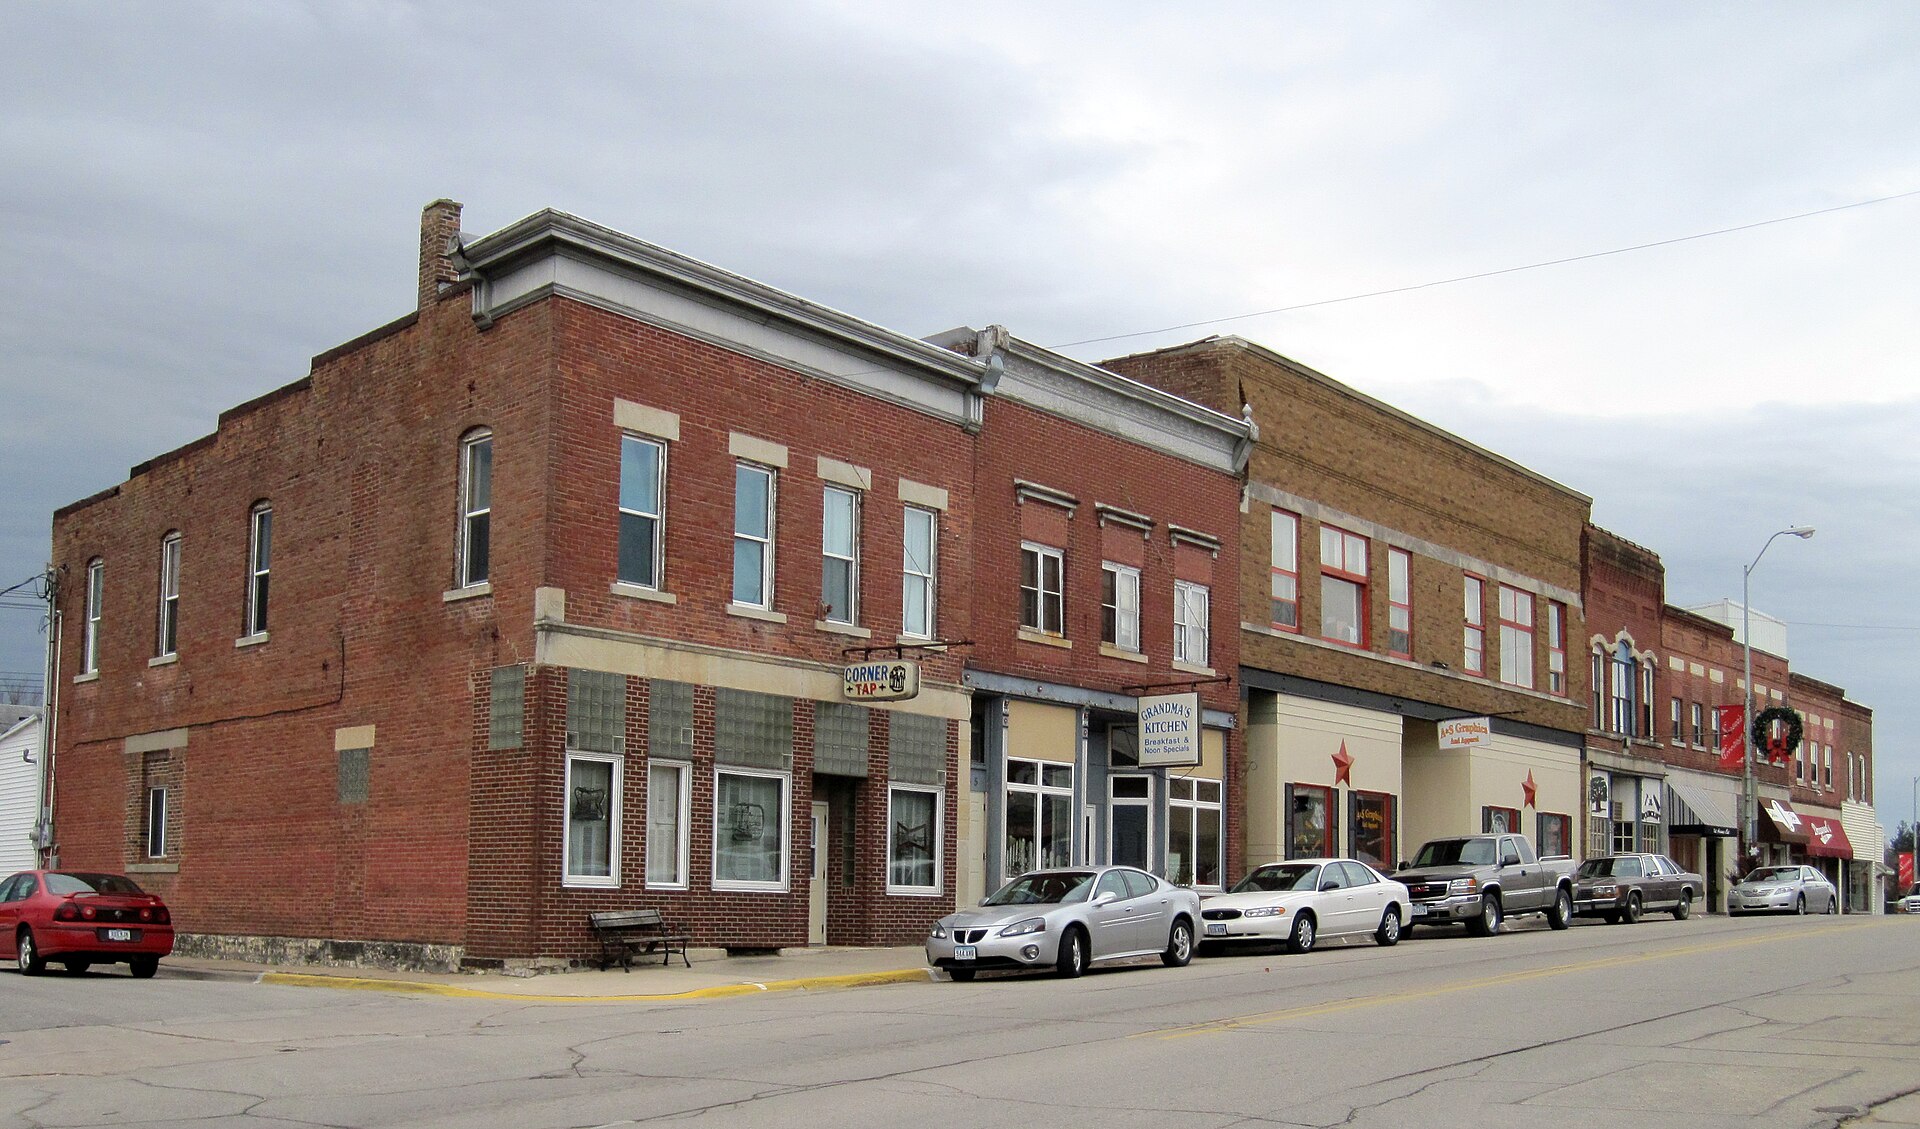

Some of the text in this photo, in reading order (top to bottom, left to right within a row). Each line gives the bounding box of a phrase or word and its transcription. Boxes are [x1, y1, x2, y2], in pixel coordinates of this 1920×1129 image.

[845, 665, 888, 682] CORNER
[855, 683, 877, 695] TAP
[1141, 702, 1192, 721] GRANDMA'S
[1145, 720, 1188, 733] KITCHEN
[1455, 722, 1488, 734] Graphics
[1144, 736, 1181, 746] Breakfast
[1163, 745, 1190, 755] Specials
